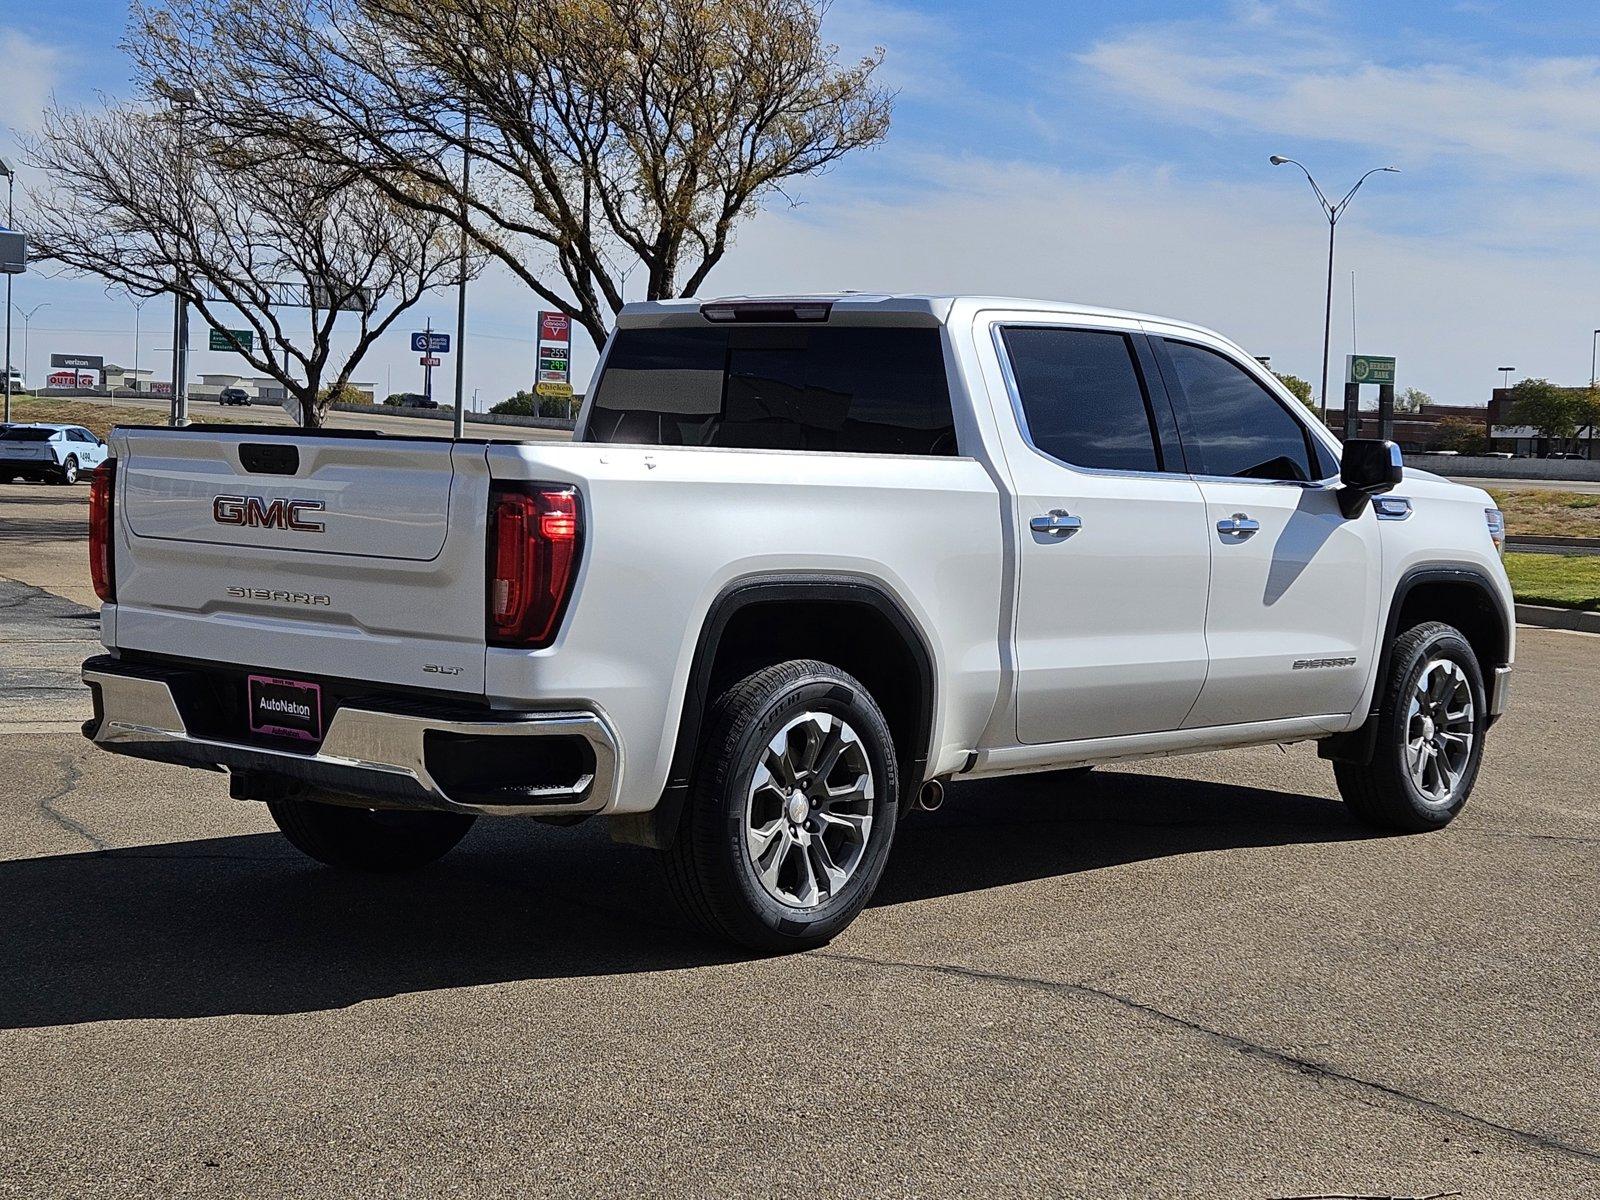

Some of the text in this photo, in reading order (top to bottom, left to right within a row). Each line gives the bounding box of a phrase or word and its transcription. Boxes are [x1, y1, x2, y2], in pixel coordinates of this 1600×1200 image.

[551, 361, 564, 369] 293
[539, 383, 571, 391] Chicken
[213, 494, 325, 533] GMC
[226, 586, 331, 606] SIERRA
[423, 663, 464, 675] SLT
[1292, 657, 1357, 669] SIERRA
[259, 696, 311, 716] AutoNation
